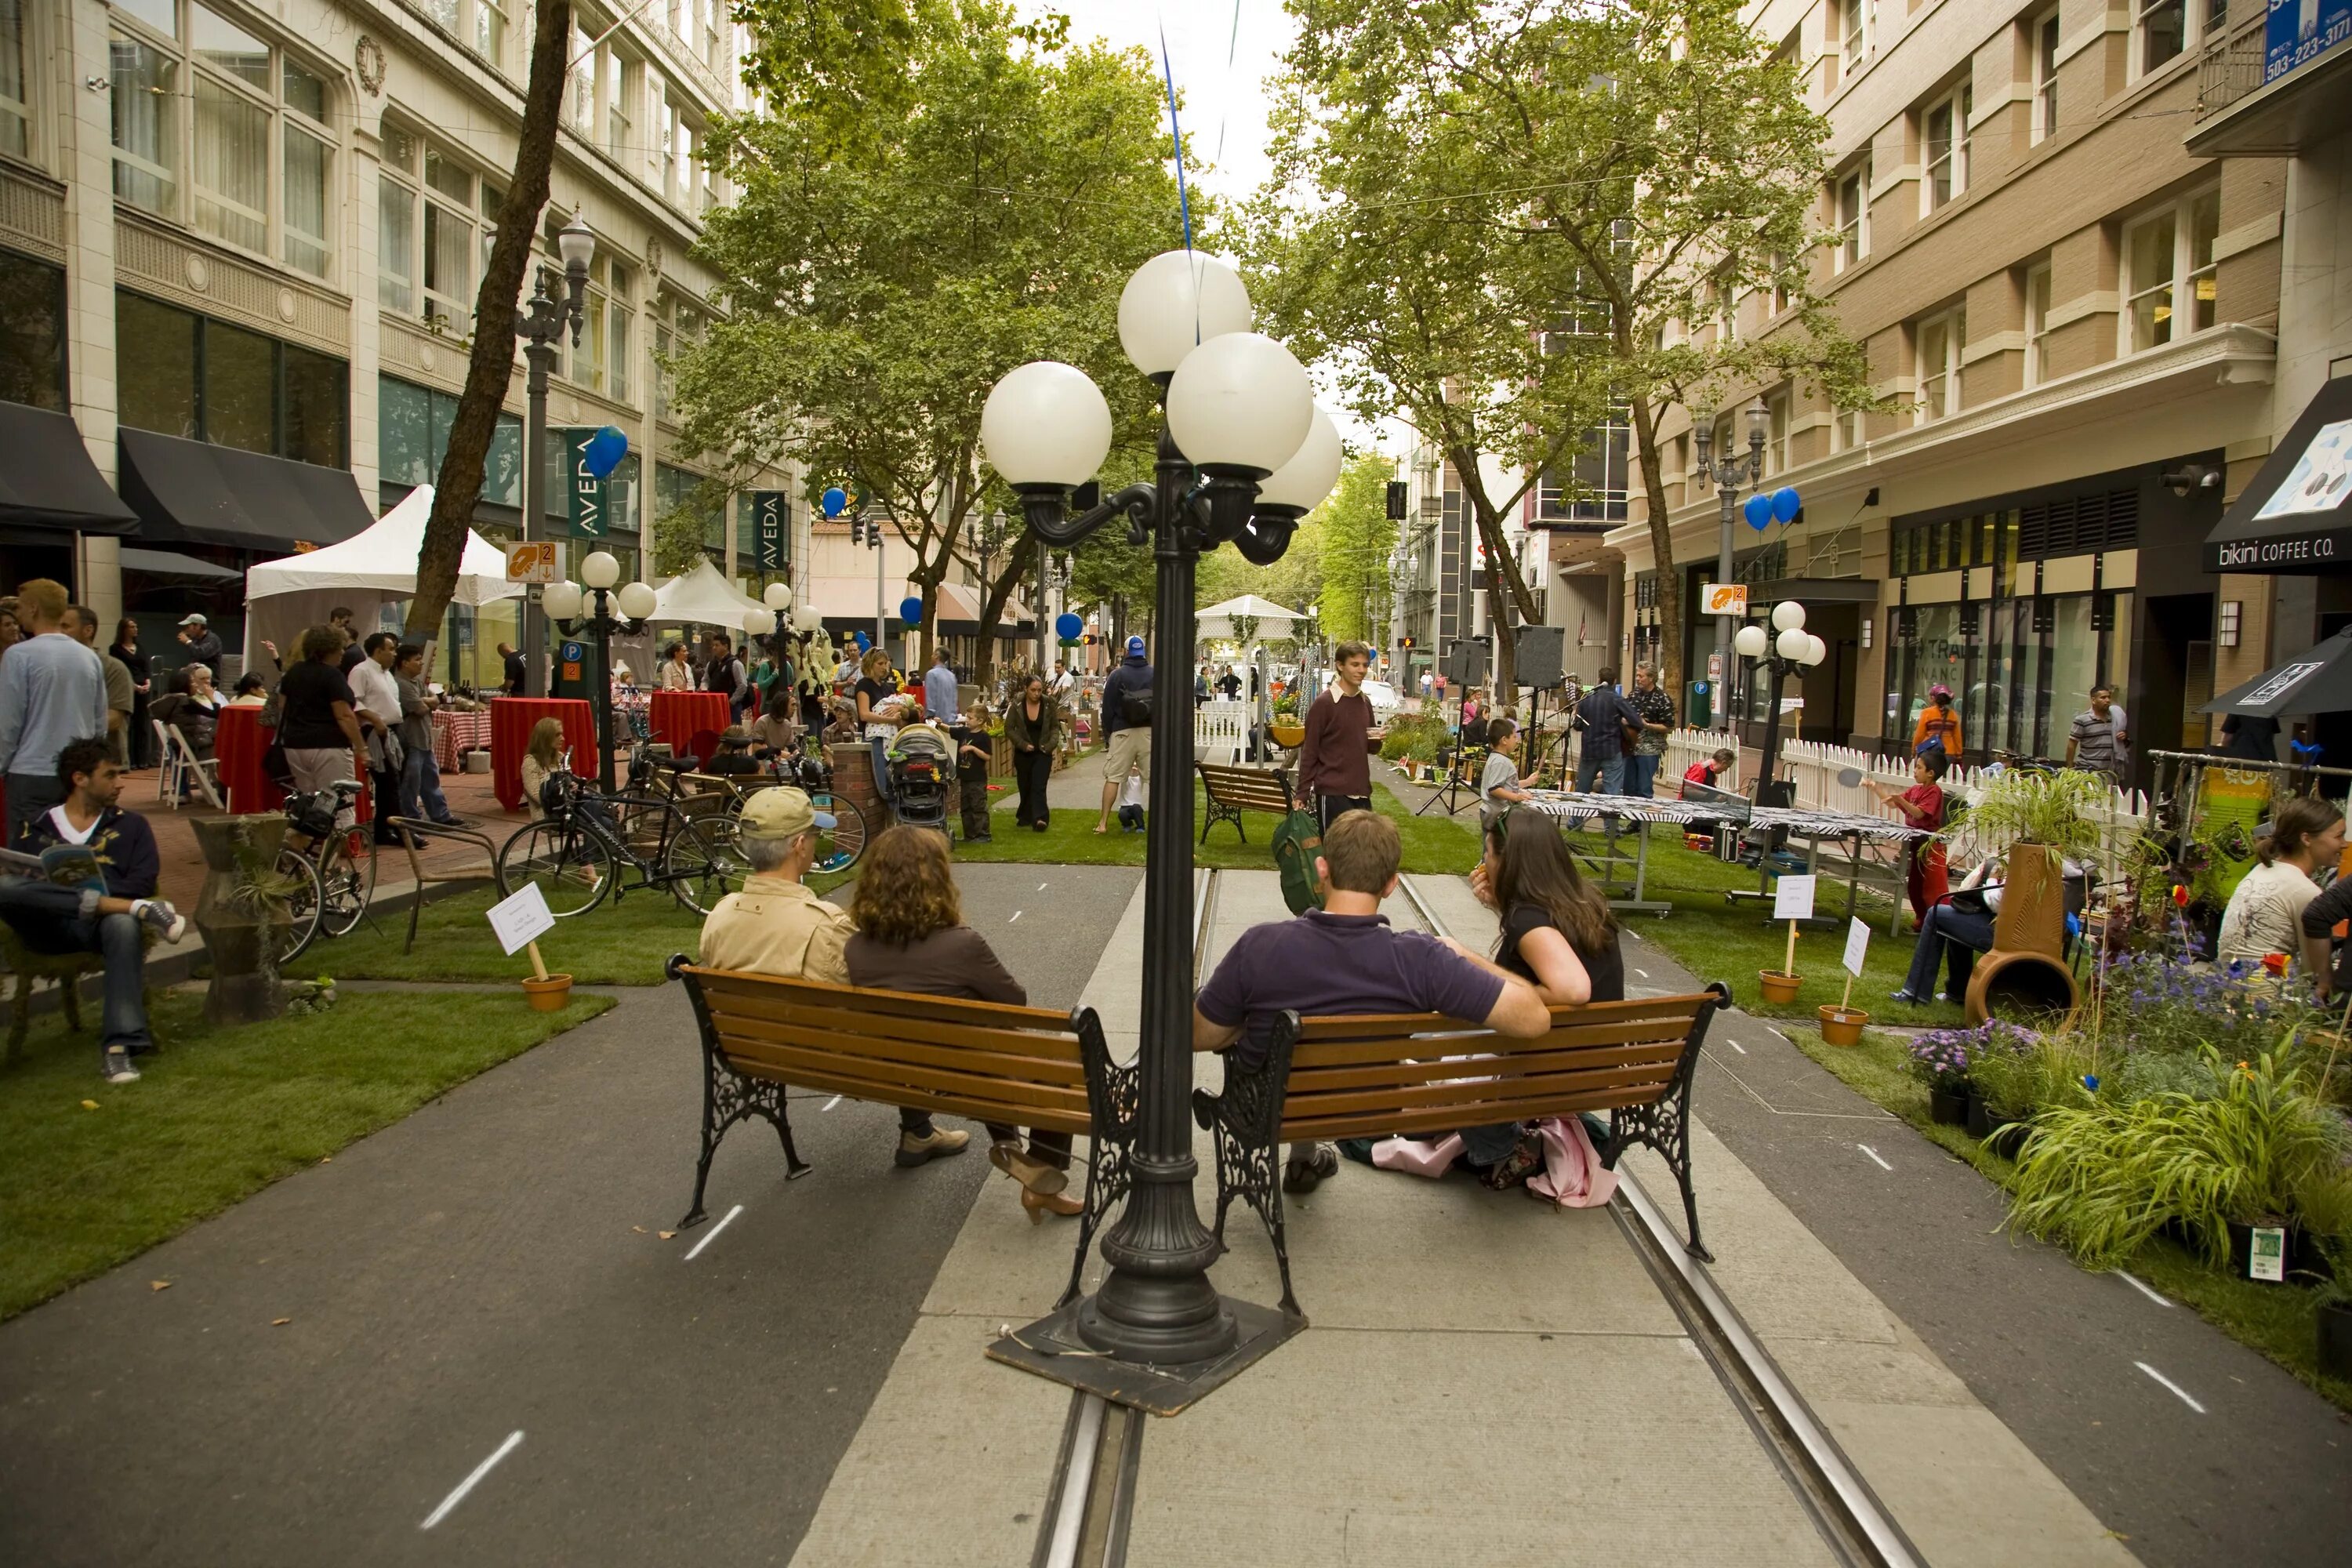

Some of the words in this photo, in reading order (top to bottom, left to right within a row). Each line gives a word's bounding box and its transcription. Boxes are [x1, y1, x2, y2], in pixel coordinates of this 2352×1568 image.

[2267, 16, 2351, 81] 503-223-3171
[763, 497, 778, 568] AVEDA
[543, 546, 551, 561] 2
[2219, 540, 2258, 566] bikini
[2262, 541, 2309, 561] COFFEE
[2314, 538, 2334, 557] CO.
[1737, 588, 1743, 598] 2
[568, 645, 578, 658] P
[568, 666, 576, 676] 2
[1699, 684, 1704, 692] P
